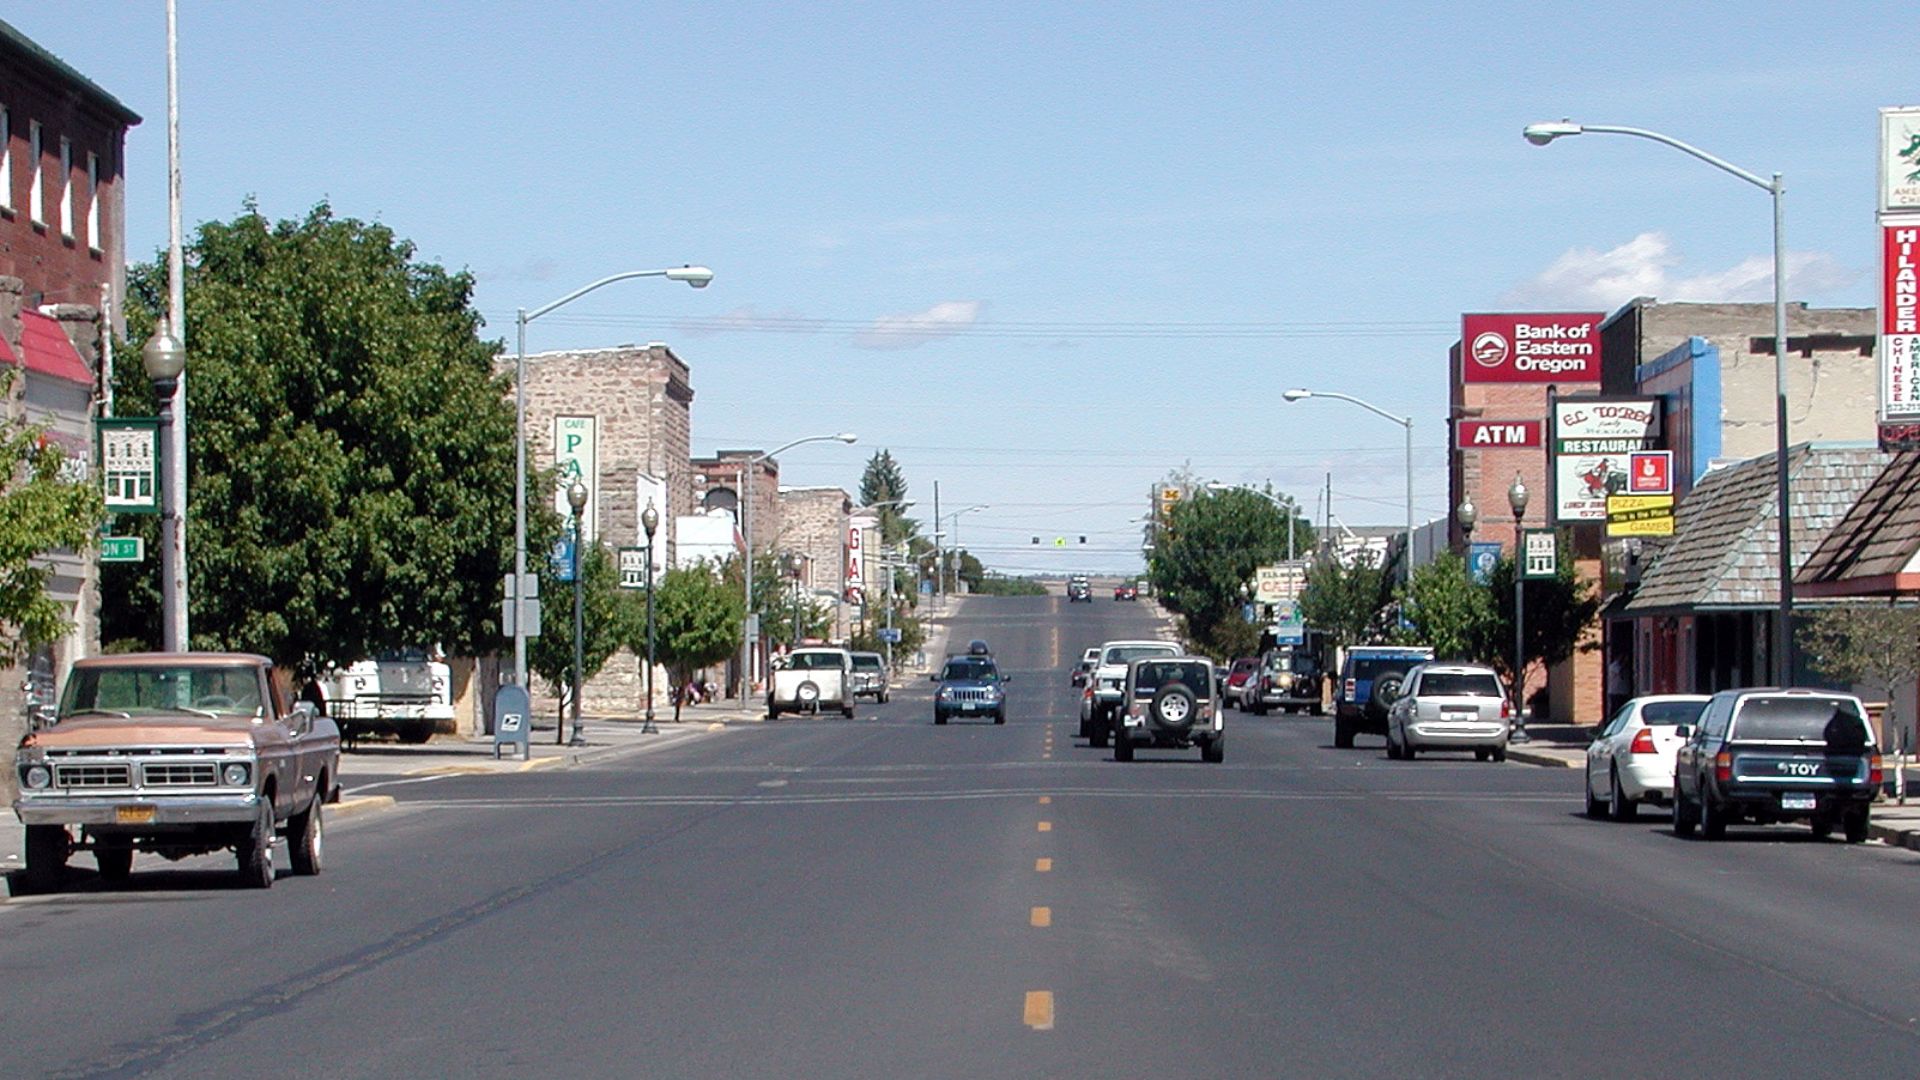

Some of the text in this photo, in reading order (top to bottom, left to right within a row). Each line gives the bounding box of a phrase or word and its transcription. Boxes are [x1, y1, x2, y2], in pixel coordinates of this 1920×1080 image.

[1895, 229, 1918, 333] HILANDER
[1514, 323, 1591, 339] Bank of
[1514, 340, 1593, 355] Eastern
[1514, 355, 1586, 373] Oregon
[1893, 337, 1903, 402] CHINESE
[1909, 337, 1920, 401] AMERICAN
[564, 419, 586, 429] CAFE
[1563, 411, 1588, 427] EL
[1473, 425, 1526, 444] ATM
[1563, 439, 1655, 453] RESTAURANT
[1611, 498, 1645, 508] PIZZA
[1629, 521, 1671, 532] GAMES
[123, 543, 134, 554] ST
[848, 527, 860, 607] GAS
[1788, 763, 1820, 776] TOY
